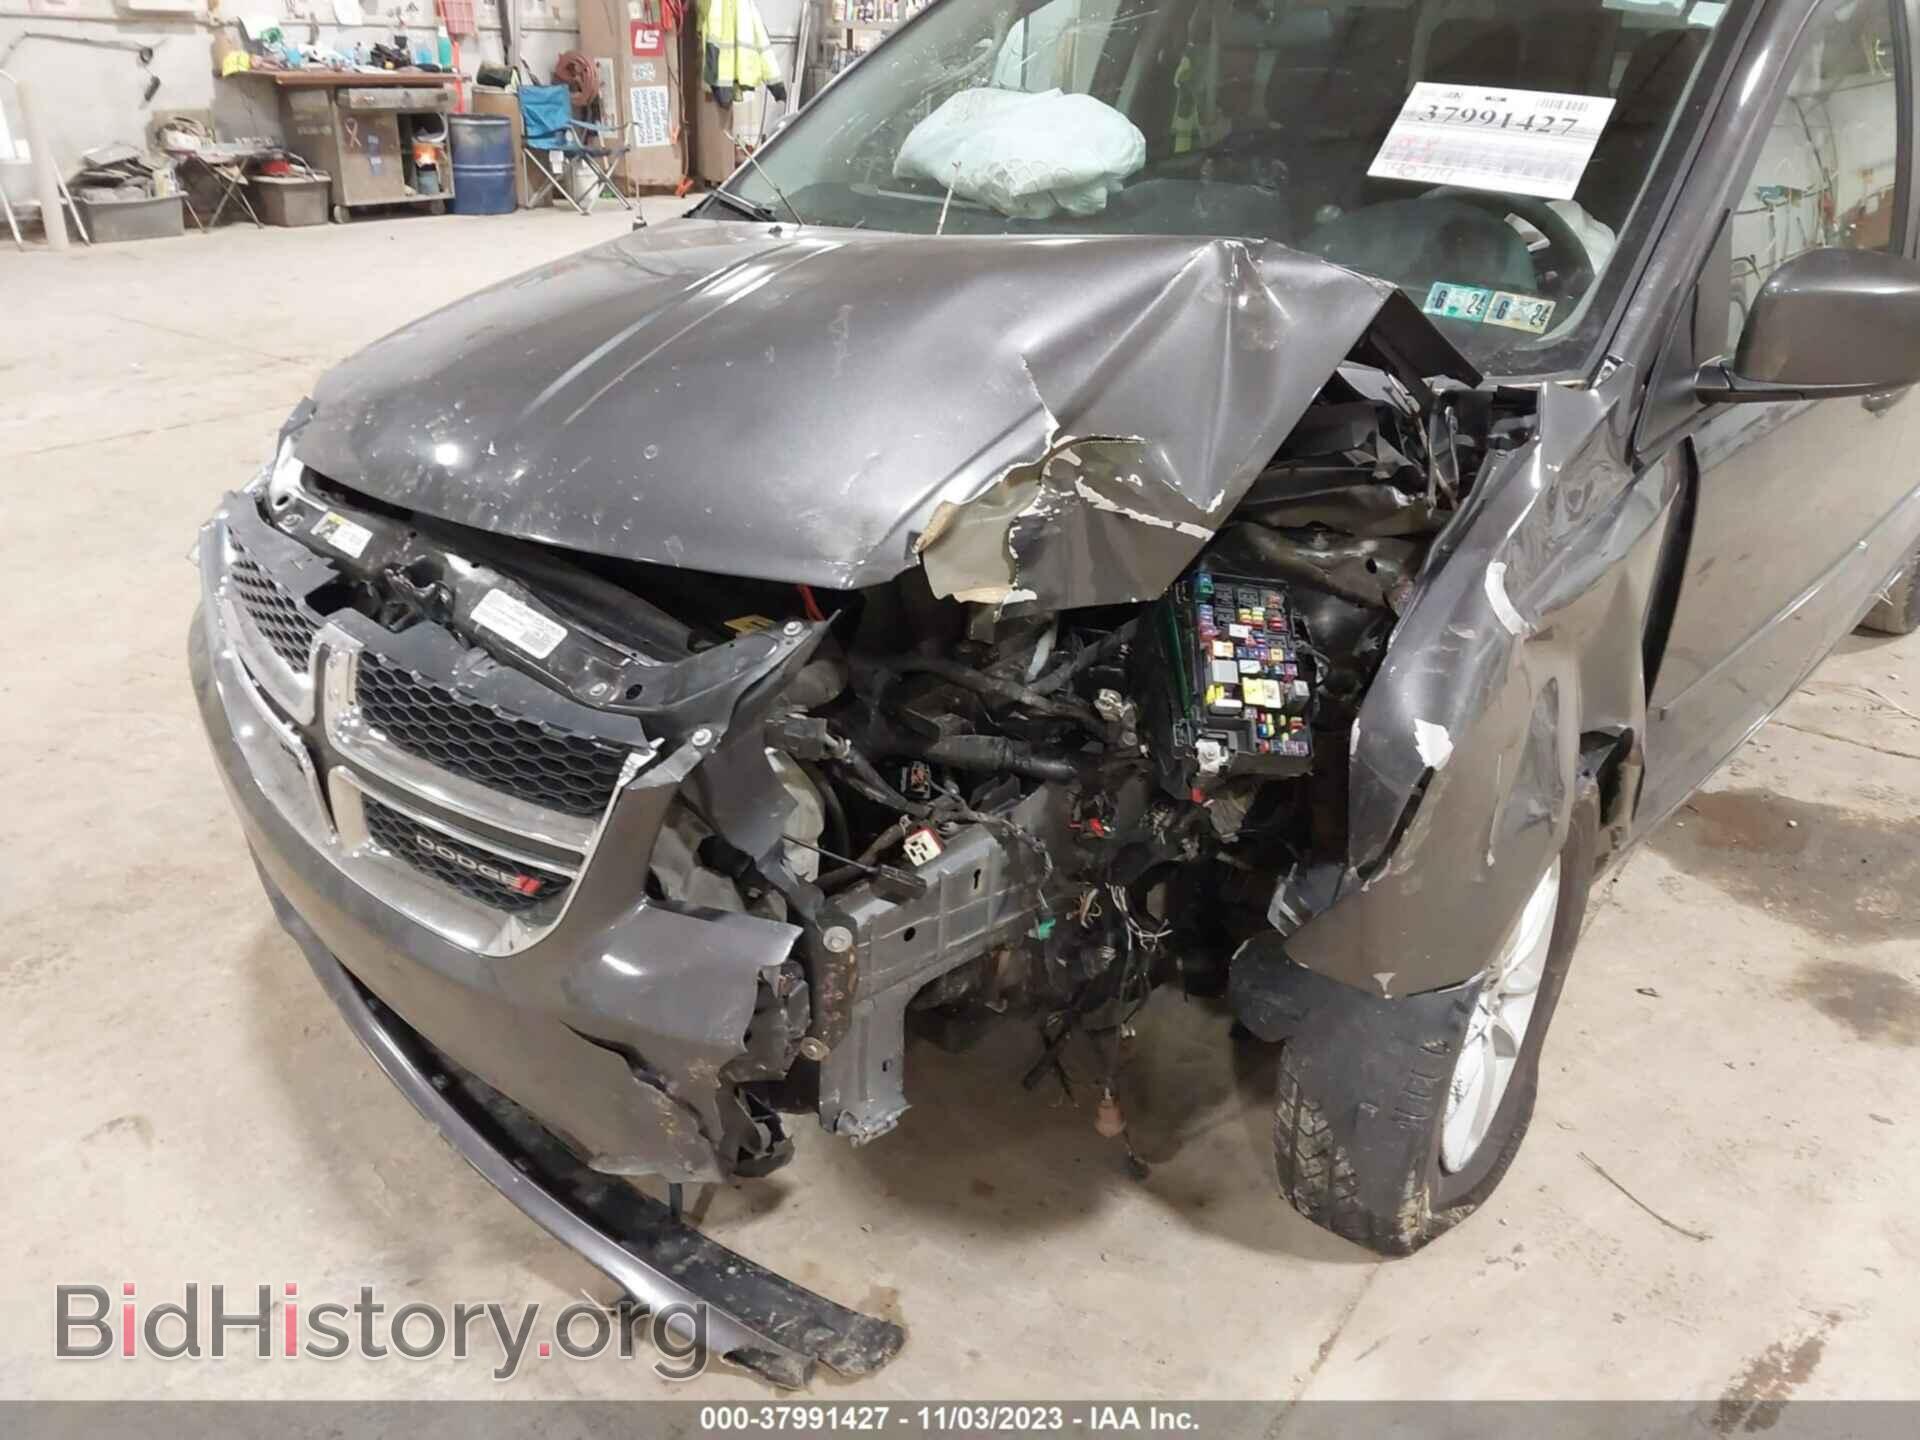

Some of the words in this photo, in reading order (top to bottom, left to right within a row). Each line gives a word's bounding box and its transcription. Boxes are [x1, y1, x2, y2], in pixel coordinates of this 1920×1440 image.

[1419, 104, 1578, 136] 37991427
[1434, 290, 1448, 309] 6
[1495, 300, 1510, 320] 6
[416, 835, 521, 891] DODGE
